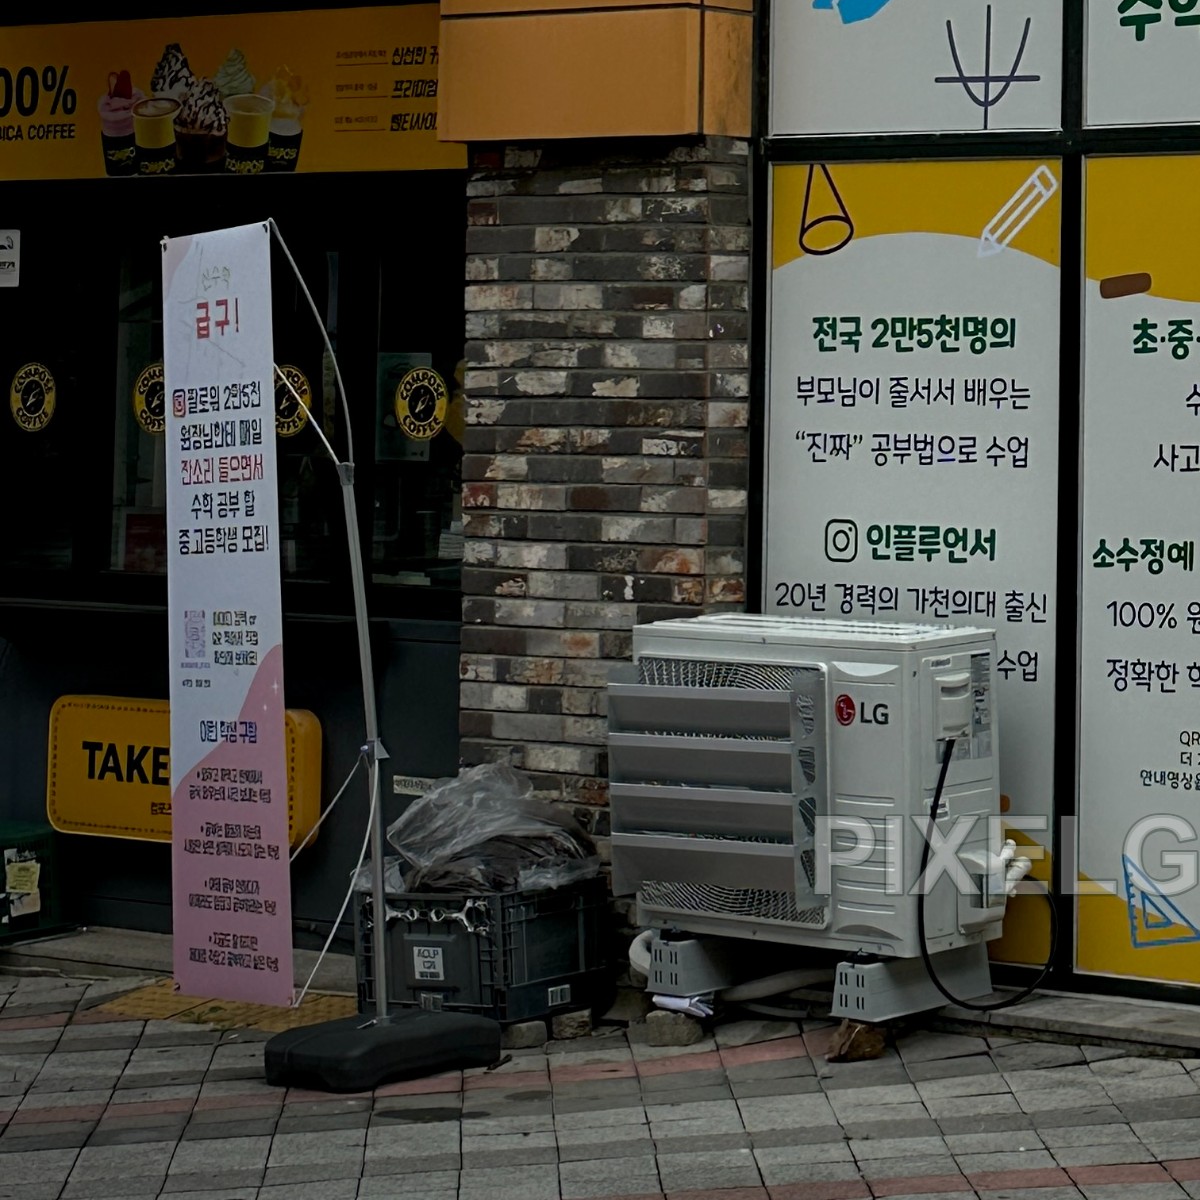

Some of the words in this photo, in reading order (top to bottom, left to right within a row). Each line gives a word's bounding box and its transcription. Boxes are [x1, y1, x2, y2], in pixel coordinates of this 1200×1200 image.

[28, 124, 76, 140] COFFEE
[812, 315, 862, 353] 전국
[871, 314, 1016, 354] 2만5천명의
[797, 376, 880, 407] 부모님이
[889, 376, 955, 408] 줄서서
[964, 377, 1031, 410] 배우는
[871, 434, 977, 467] 공부법으로
[986, 436, 1029, 468] 수업
[181, 457, 214, 486] 잔소리
[191, 492, 213, 520] 수학
[217, 490, 240, 518] 공부
[179, 527, 238, 555] 중고등학생
[866, 524, 996, 563] 인플루언서
[1092, 538, 1195, 574] 소수정예
[775, 582, 826, 612] 20년
[834, 583, 899, 615] 경력의
[907, 585, 996, 618] 가천의대
[1005, 590, 1047, 623] 출신
[1106, 600, 1177, 629] 100%
[997, 650, 1038, 682] 수업
[1106, 658, 1179, 693] 정확한
[860, 702, 889, 725] LG
[82, 741, 170, 785] TAKE
[1180, 752, 1192, 767] 더
